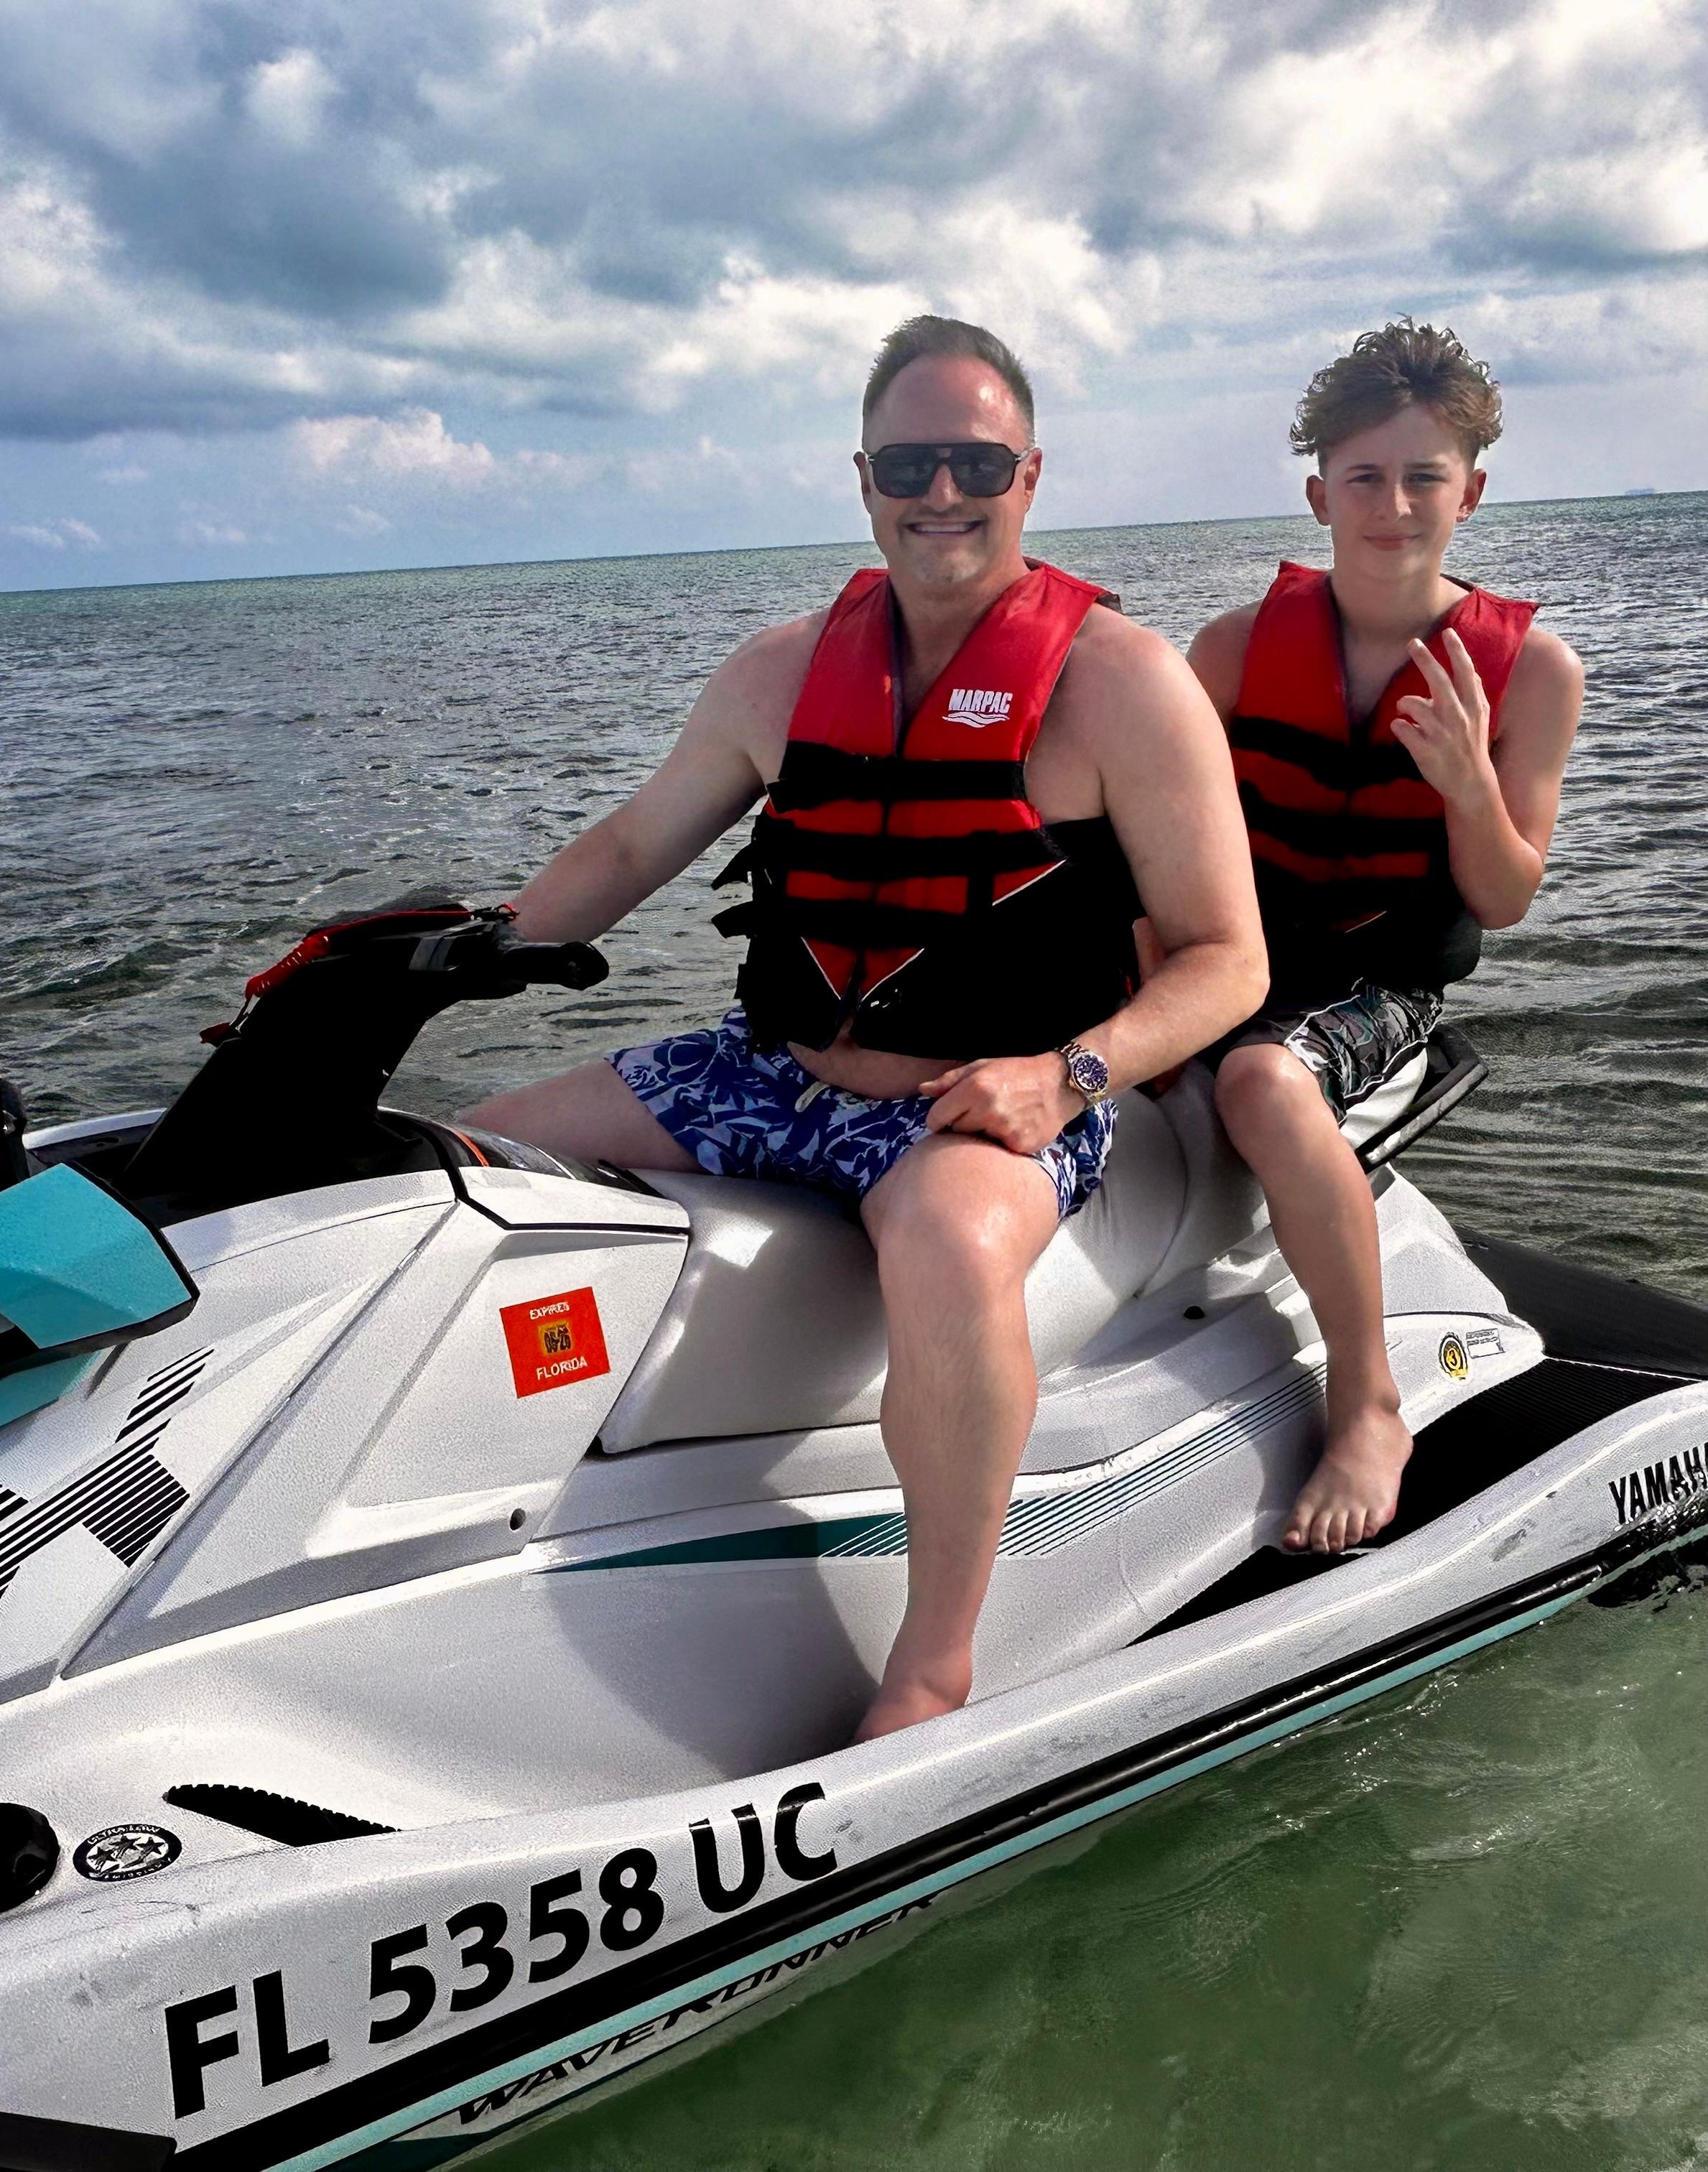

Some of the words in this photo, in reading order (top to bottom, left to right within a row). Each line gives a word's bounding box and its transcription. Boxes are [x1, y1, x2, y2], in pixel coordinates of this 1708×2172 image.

[948, 689, 1013, 713] MARPAC
[536, 1356, 588, 1380] FLORIDA
[1608, 1442, 1708, 1525] YAMAH
[164, 1969, 330, 2120] FL
[368, 1848, 664, 2044] 5358
[688, 1782, 838, 1913] UC
